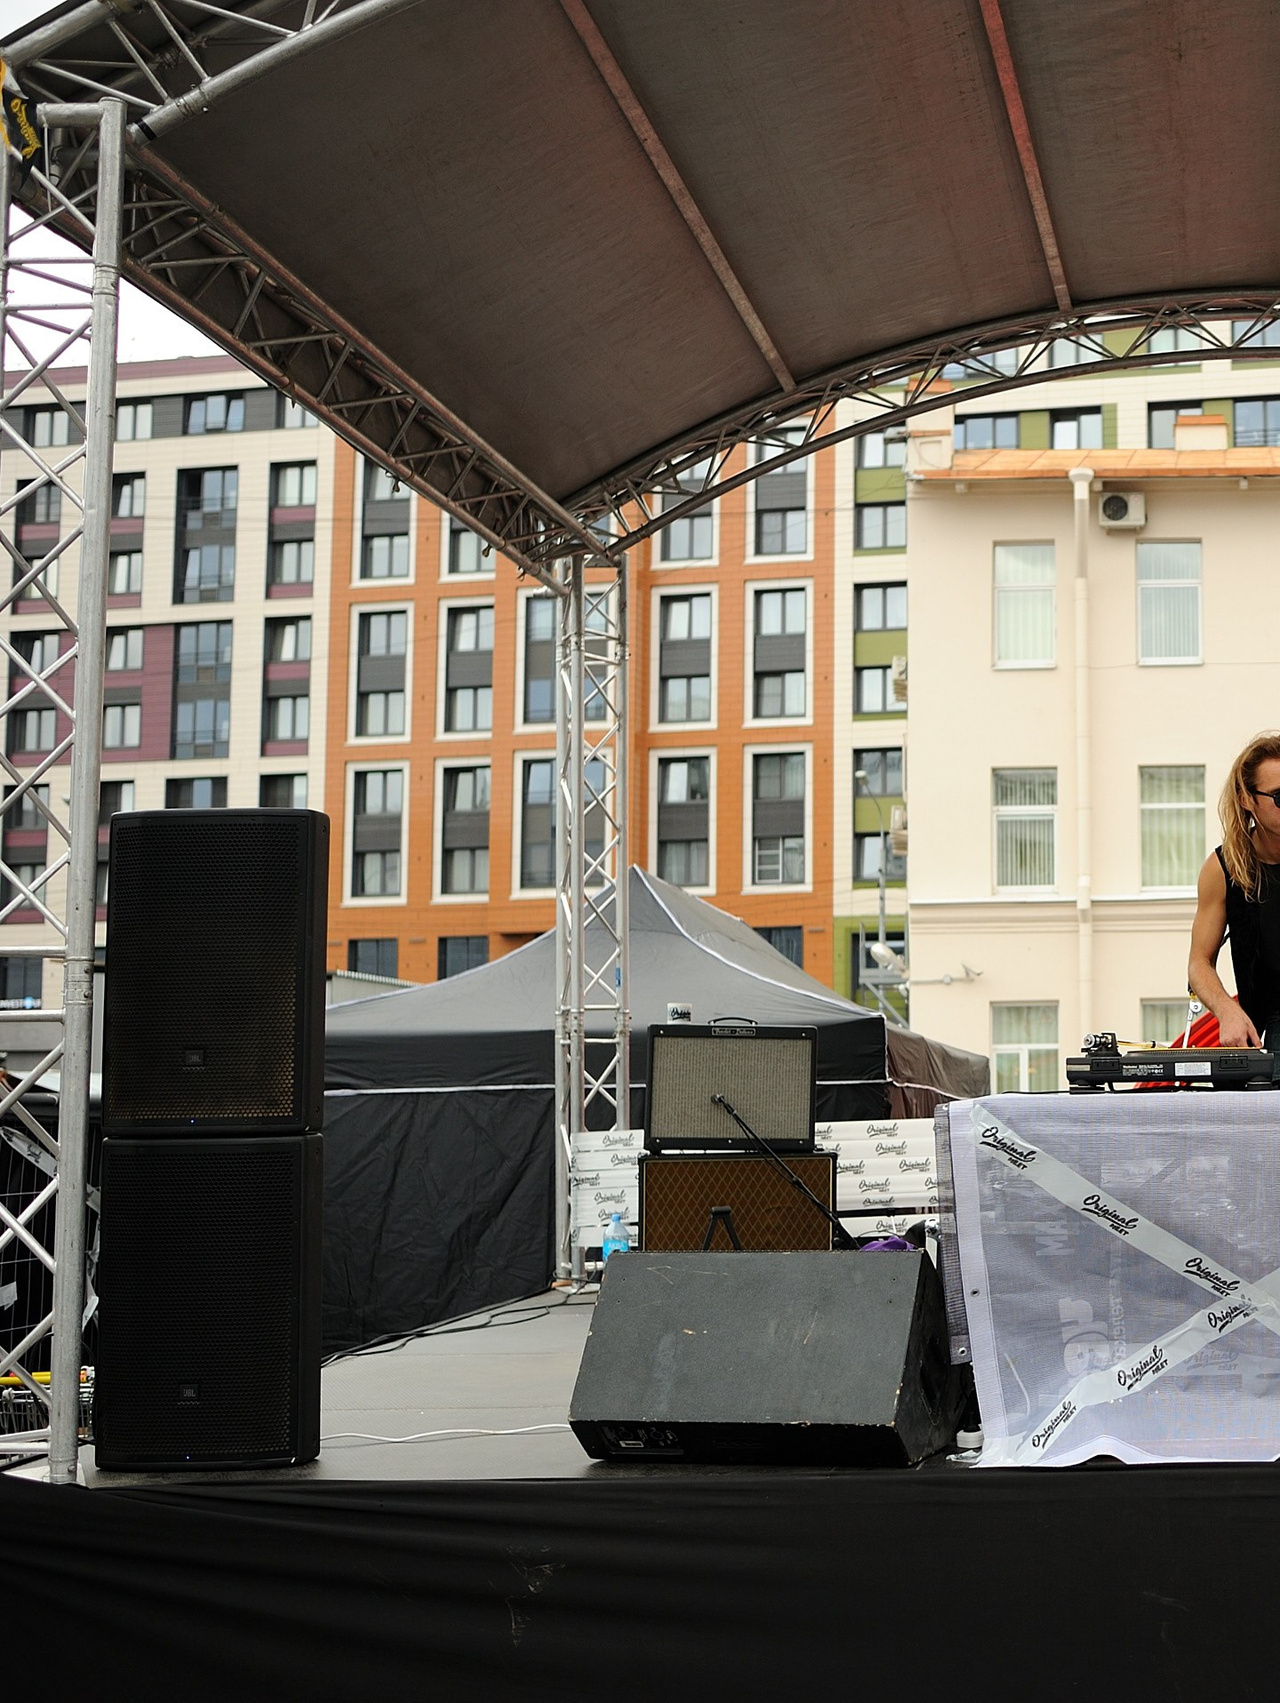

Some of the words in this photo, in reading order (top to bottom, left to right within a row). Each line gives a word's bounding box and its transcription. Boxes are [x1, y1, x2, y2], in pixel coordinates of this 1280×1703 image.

[867, 1122, 899, 1137] Original
[980, 1127, 1037, 1163] Original
[875, 1141, 907, 1156] Original
[899, 1157, 931, 1173] Original
[859, 1178, 891, 1193] Original
[1080, 1194, 1139, 1229] Original
[1183, 1257, 1240, 1291] Original
[1117, 1345, 1163, 1391] Original
[1032, 1401, 1071, 1449] Original
